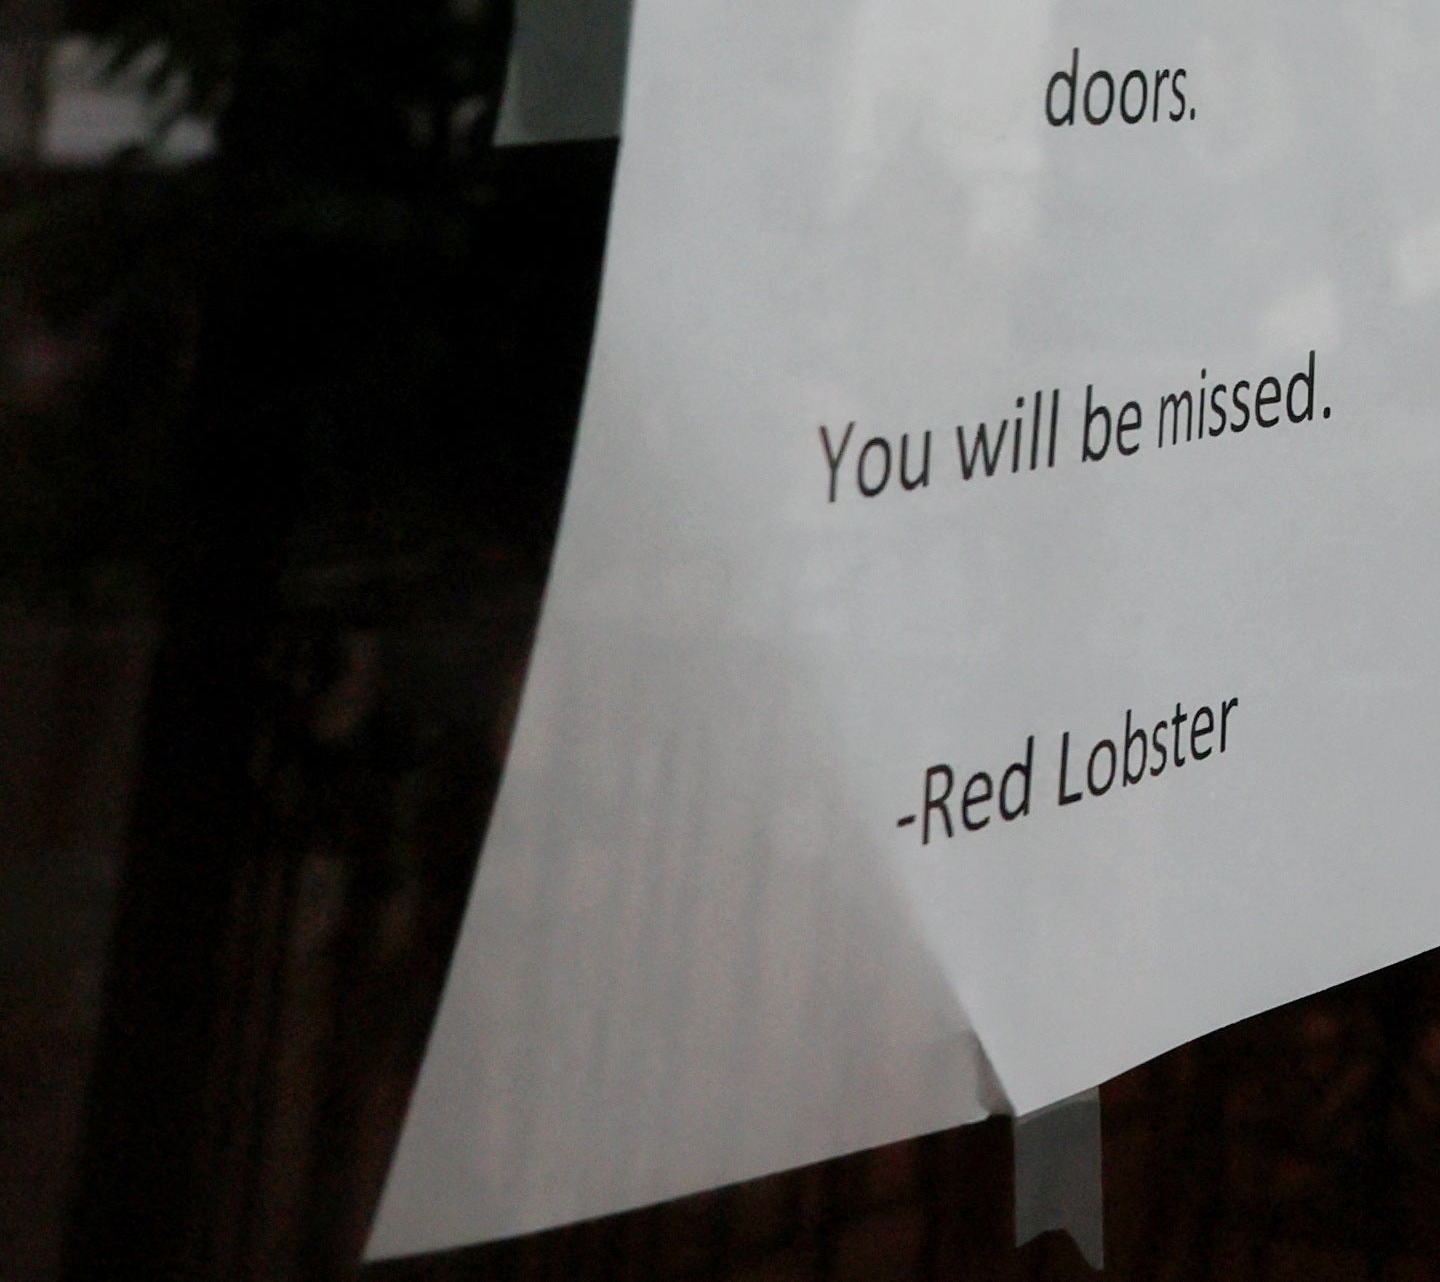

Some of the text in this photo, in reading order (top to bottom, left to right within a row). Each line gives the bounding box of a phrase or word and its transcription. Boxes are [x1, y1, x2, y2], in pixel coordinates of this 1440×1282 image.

[1042, 45, 1198, 129] doors.
[816, 348, 1333, 505] You will be missed.
[894, 695, 1241, 848] -Red Lobster
